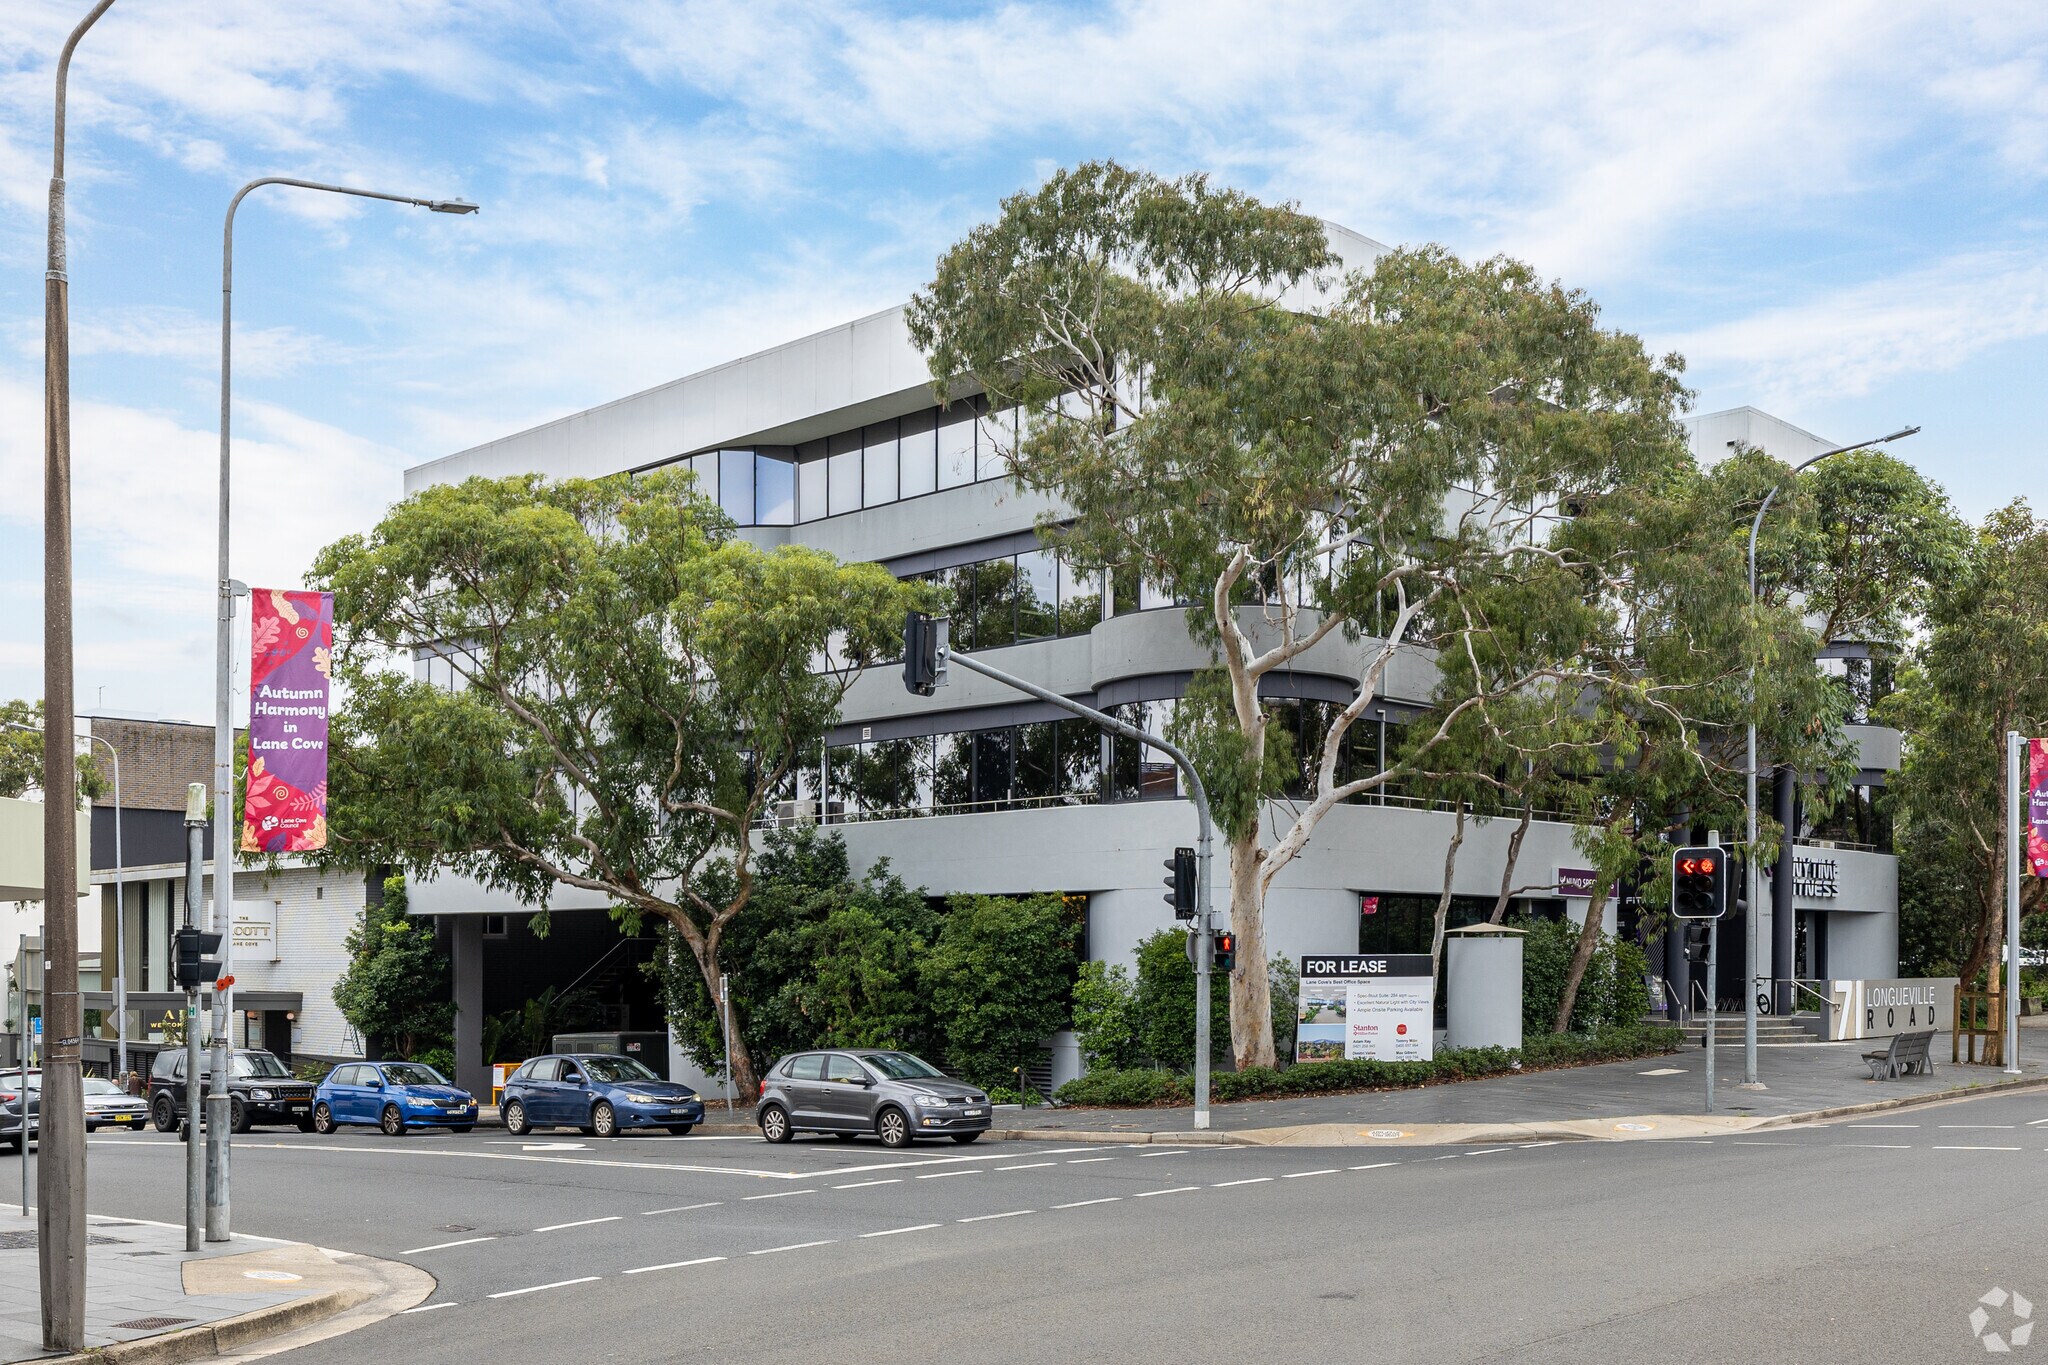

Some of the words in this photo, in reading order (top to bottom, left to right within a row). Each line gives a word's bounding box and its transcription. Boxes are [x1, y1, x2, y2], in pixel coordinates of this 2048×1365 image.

[259, 684, 324, 700] Autumn
[254, 702, 326, 719] Harmony
[283, 721, 298, 733] in
[252, 737, 289, 750] Lane
[291, 737, 324, 750] Cove
[1792, 857, 1838, 880] NYTIME
[1792, 879, 1838, 897] ITNESS
[1306, 961, 1336, 973] FOR
[1340, 961, 1387, 973] LEASE
[1867, 987, 1935, 1007] LONGUEVILLE
[188, 1006, 195, 1016] H
[1835, 980, 1862, 1040] 71
[1867, 1006, 1935, 1029] ROAD
